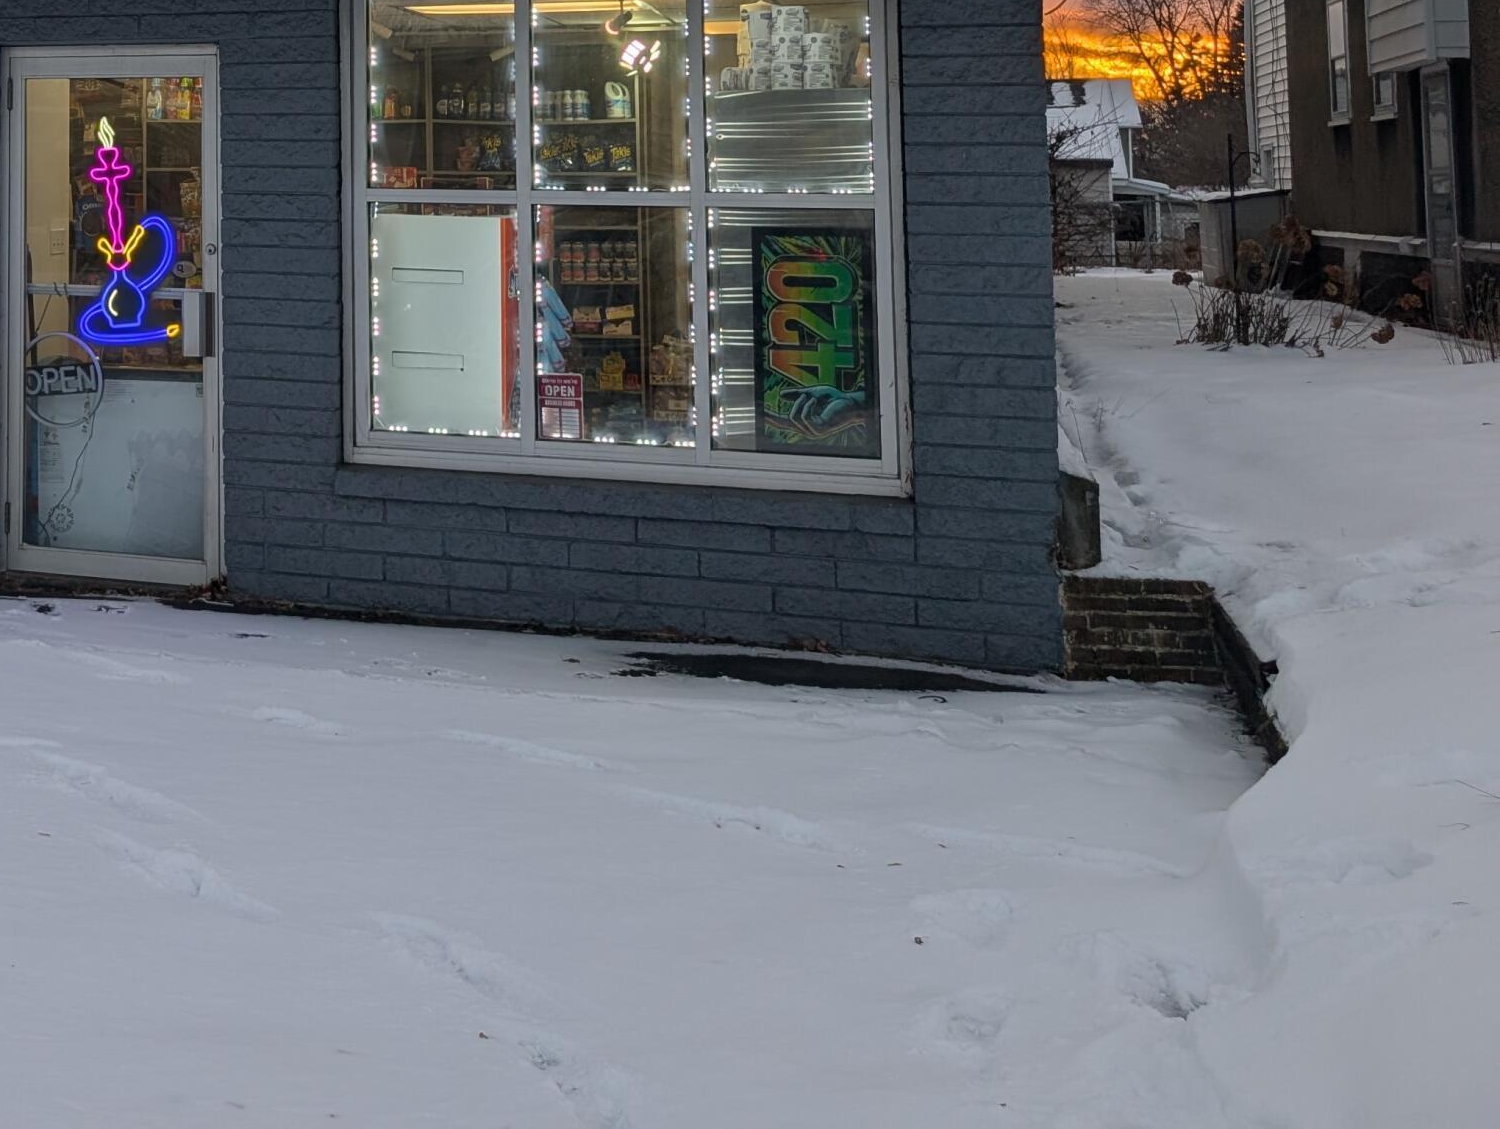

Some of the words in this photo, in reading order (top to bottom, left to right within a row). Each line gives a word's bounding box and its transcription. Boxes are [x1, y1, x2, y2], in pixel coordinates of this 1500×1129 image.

[766, 257, 858, 388] 420
[26, 365, 97, 396] OPEN
[545, 384, 575, 397] OPEN
